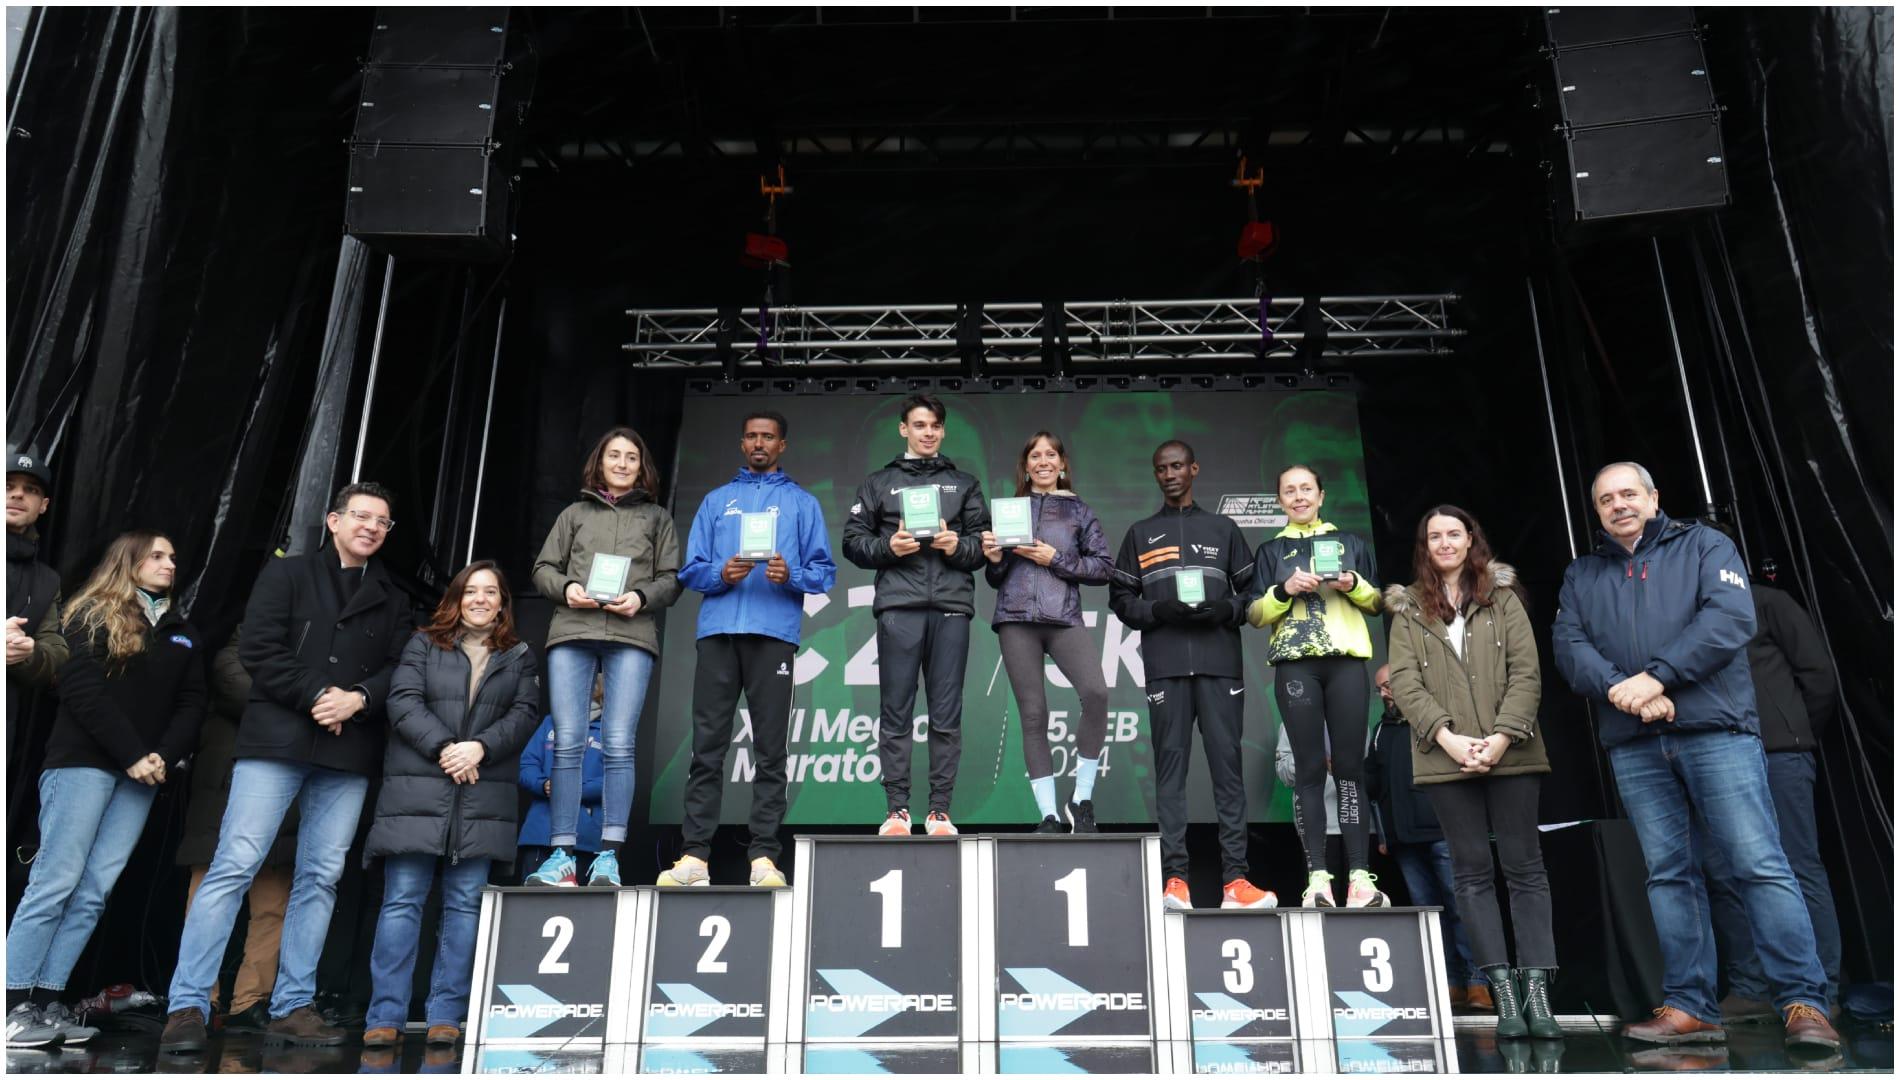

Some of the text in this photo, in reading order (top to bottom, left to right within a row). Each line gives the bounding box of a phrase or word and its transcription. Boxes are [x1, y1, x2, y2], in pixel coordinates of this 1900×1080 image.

[869, 869, 903, 948] 1
[1054, 867, 1090, 947] 1
[537, 915, 574, 975] 2
[696, 915, 731, 974] 2
[1221, 938, 1255, 995] 3
[1359, 936, 1395, 994] 3
[490, 1004, 604, 1019] POWERADE
[650, 1002, 765, 1018] POWERADE
[810, 994, 957, 1012] POWERADE
[1000, 992, 1147, 1011] POWERADE
[1192, 1008, 1288, 1021] POWERADE
[1334, 1007, 1430, 1020] POWERADE
